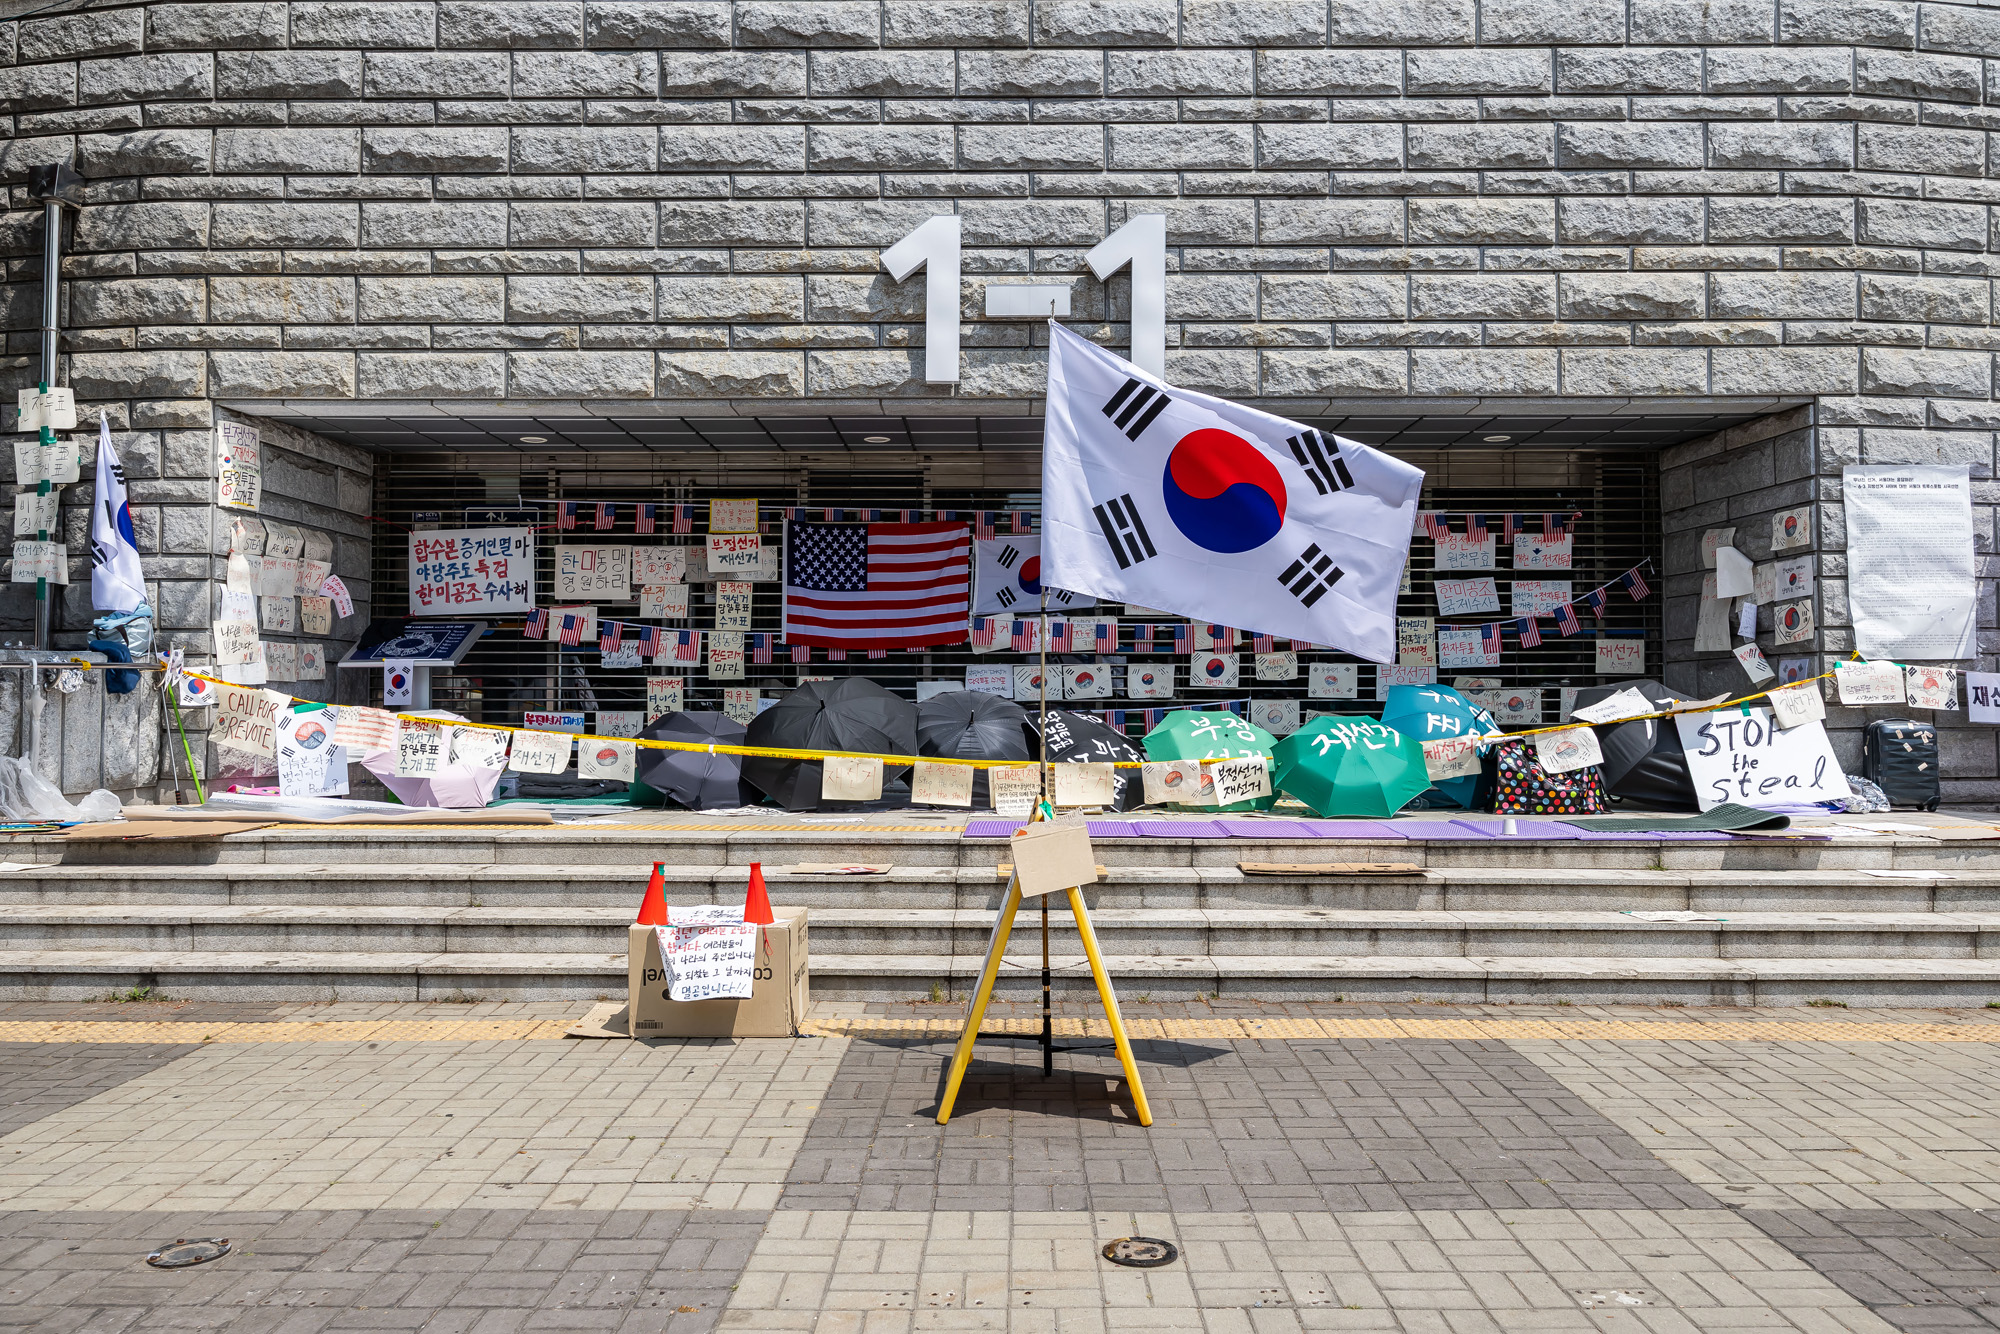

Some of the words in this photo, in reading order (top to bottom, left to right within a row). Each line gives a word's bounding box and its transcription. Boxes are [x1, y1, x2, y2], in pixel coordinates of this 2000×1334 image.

[880, 213, 1166, 385] 1-1
[21, 393, 66, 423] 전자투표
[222, 423, 257, 447] 부정선거
[20, 446, 69, 466] 당일투표
[233, 446, 257, 465] 재선거
[223, 470, 257, 491] 당일투표
[232, 487, 255, 506] 수개표
[413, 538, 459, 563] 합수본
[460, 536, 513, 559] 증거인멸
[514, 536, 530, 558] 마
[711, 535, 759, 552] 부정선거
[718, 551, 759, 566] 재선거
[1447, 551, 1492, 568] 원천무효
[1515, 554, 1530, 567] 개헌
[1541, 554, 1572, 567] 전자투표
[416, 562, 475, 583] 야당주도
[474, 558, 508, 580] 특검
[561, 573, 627, 594] 영원하라
[719, 582, 752, 594] 부정선거
[1438, 580, 1495, 599] 한미공조
[414, 581, 483, 606] 한미공조
[483, 580, 529, 603] 수사해
[641, 586, 687, 603] 부정선거
[720, 594, 749, 605] 재선거
[1538, 591, 1569, 602] 전자투표
[302, 596, 328, 610] 부정선거
[650, 604, 686, 618] 재선거
[718, 603, 749, 614] 당일투표
[1441, 597, 1495, 613] 국제수사
[719, 616, 748, 628] 수개표
[710, 649, 744, 662] 건드리지
[1400, 645, 1427, 656] 이재명
[1598, 643, 1641, 660] 재선거
[1452, 655, 1485, 666] CBDC
[1485, 654, 1499, 665] 도입
[715, 662, 740, 676] 마라
[1379, 665, 1430, 684] 부정선거
[1843, 664, 1875, 676] 부정선거
[1920, 667, 1944, 680] 부정선거
[1868, 674, 1898, 683] 재선거
[725, 690, 753, 703] 자유는
[1845, 684, 1871, 695] 당일투표
[228, 692, 255, 717] CALL
[257, 701, 280, 724] FOR
[728, 703, 749, 713] 거저
[1920, 696, 1940, 708] 재선거
[525, 713, 562, 726] 부정선거
[562, 716, 584, 726] 재선거
[600, 713, 625, 725] 부정선거
[611, 720, 638, 733] 재선거
[225, 716, 273, 750] RE-VOTE
[1190, 716, 1256, 741] 부정
[403, 732, 436, 744] 재선거
[1311, 722, 1399, 757] 재선거
[400, 743, 440, 759] 당일투표
[1424, 738, 1474, 762] 재선거
[399, 758, 438, 775] 수개표
[513, 749, 556, 773] 재선거
[1732, 754, 1759, 773] the
[825, 764, 877, 793] 재선거
[1218, 763, 1263, 784] 부정선거
[916, 789, 932, 801] Stop
[937, 790, 948, 799] the
[1223, 780, 1261, 799] 재선거
[669, 925, 694, 941] 청년
[698, 926, 726, 938] 여러분
[703, 939, 743, 949] 여러분들이
[680, 953, 707, 964] 나라의
[685, 969, 709, 980] 되찾는
[713, 969, 720, 977] 그
[726, 966, 752, 977] 날까지
[681, 981, 747, 1000] 멸공입니다!!
